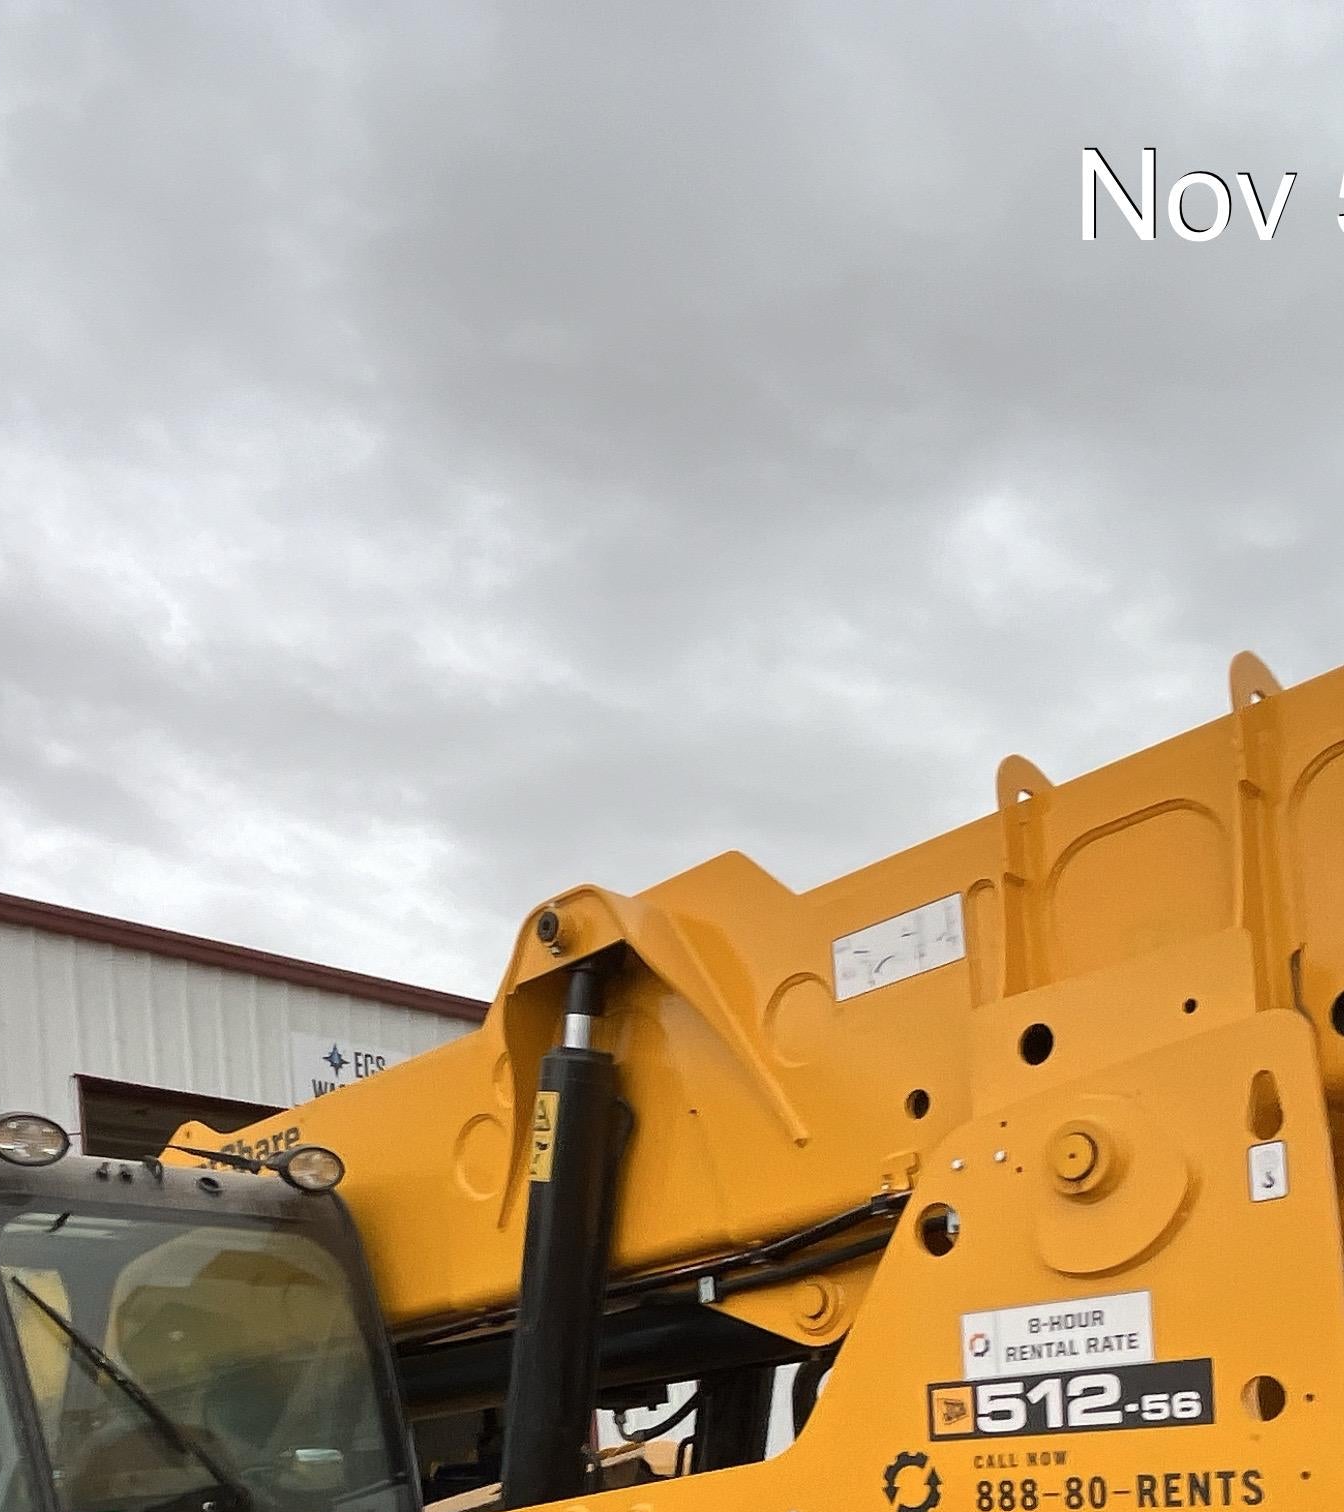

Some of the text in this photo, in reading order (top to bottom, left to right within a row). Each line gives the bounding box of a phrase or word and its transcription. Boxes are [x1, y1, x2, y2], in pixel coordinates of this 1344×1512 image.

[354, 1051, 386, 1078] ECS
[1028, 1309, 1105, 1334] 8-HOUR
[1006, 1332, 1140, 1362] RENTAL RATE
[975, 1373, 1203, 1433] 512-56
[973, 1453, 1018, 1469] CALL
[975, 1469, 1264, 1512] 888-80-RENTS
